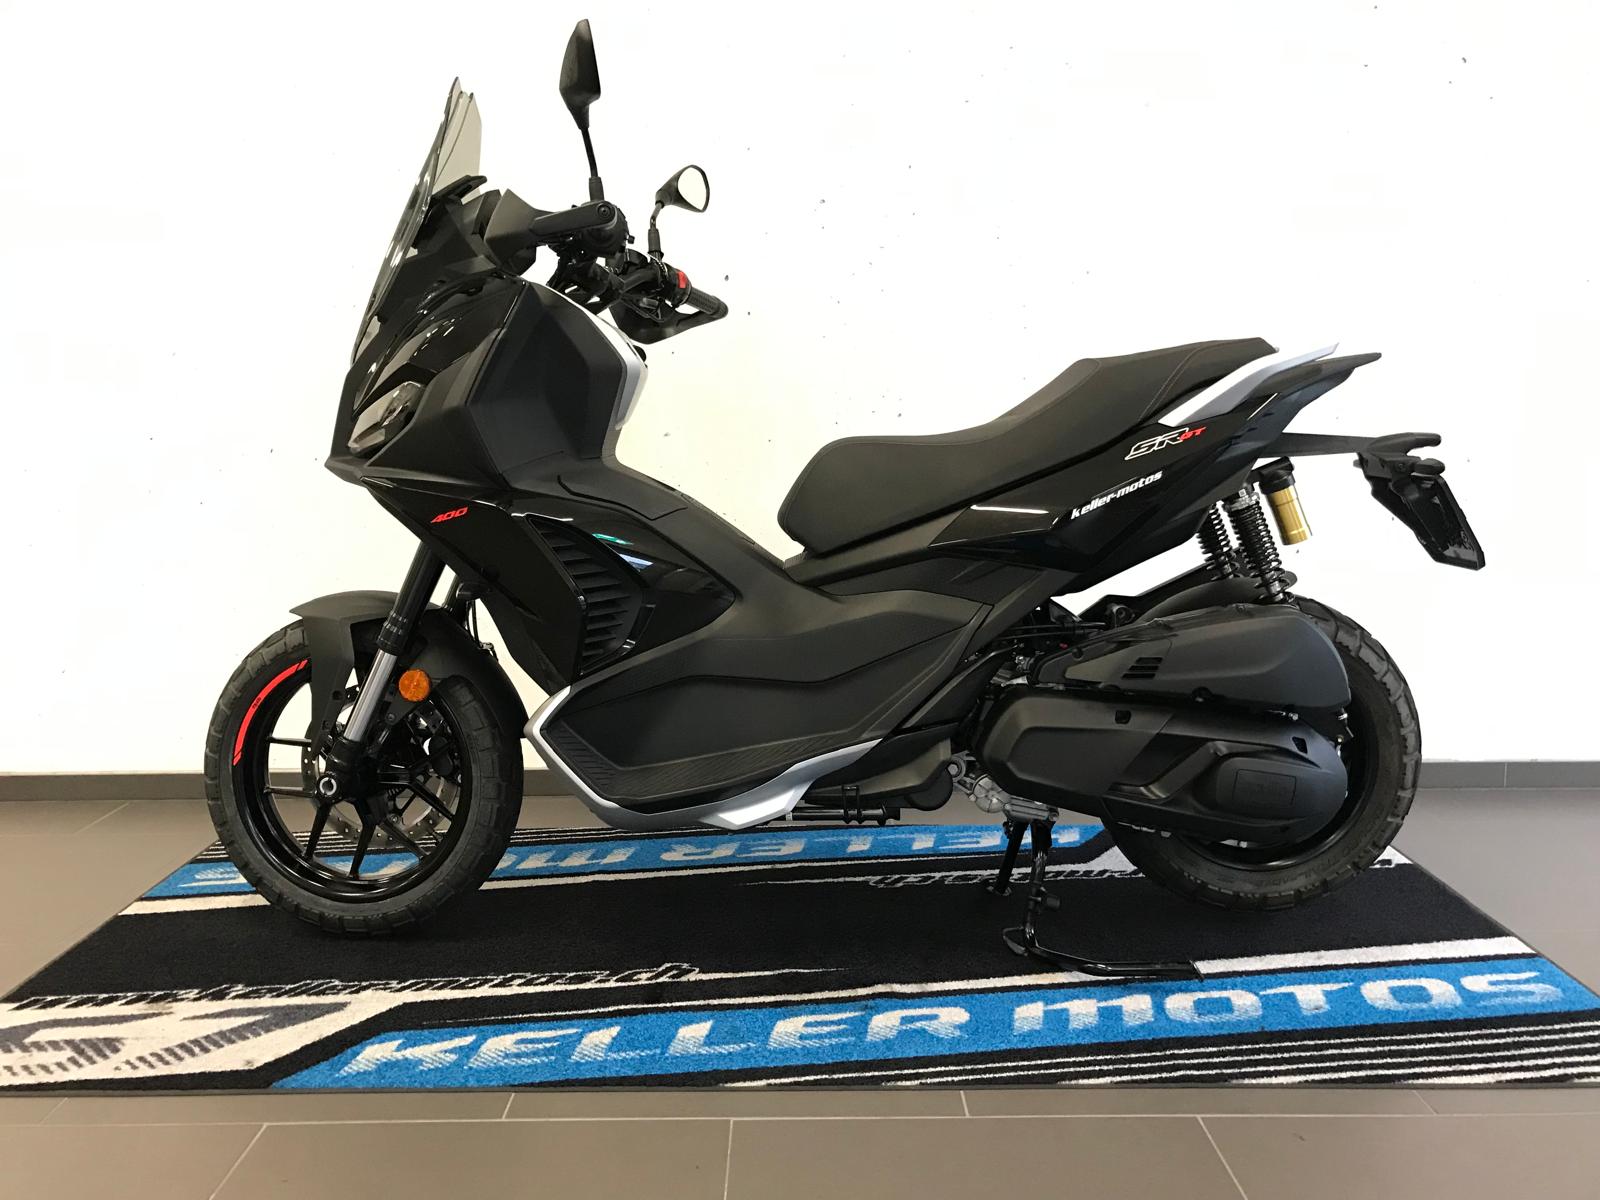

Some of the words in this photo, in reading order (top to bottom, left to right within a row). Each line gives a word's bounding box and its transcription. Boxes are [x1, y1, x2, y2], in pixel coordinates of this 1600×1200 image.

[430, 506, 468, 523] 400
[1070, 470, 1163, 520] keller-motos
[337, 1006, 970, 1077] KELLER
[1012, 971, 1564, 1035] MOTOS
